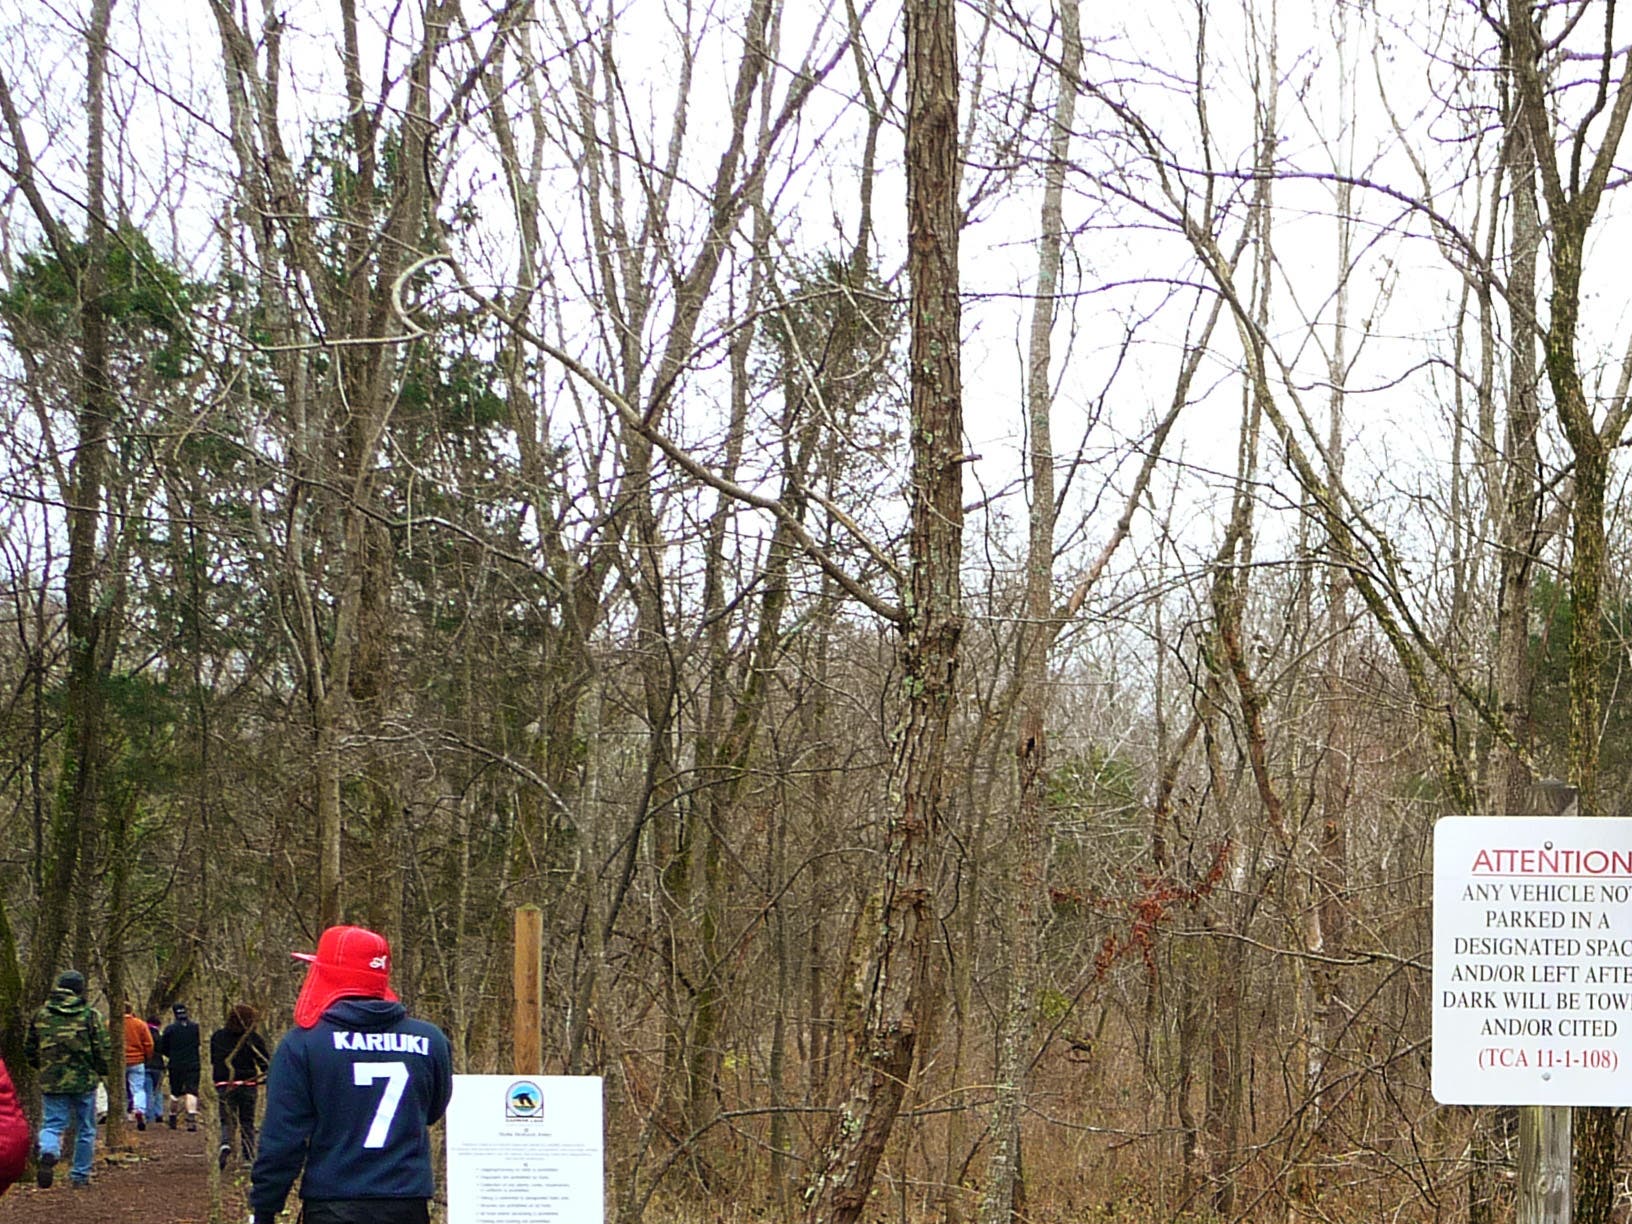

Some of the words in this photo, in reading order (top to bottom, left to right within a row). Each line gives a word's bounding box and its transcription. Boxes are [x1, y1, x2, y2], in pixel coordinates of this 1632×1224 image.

[1471, 849, 1632, 874] ATTENTION
[1462, 884, 1503, 902] ANY
[1509, 885, 1595, 902] VEHICLE
[1486, 910, 1565, 929] PARKED
[1571, 911, 1591, 929] IN
[1597, 912, 1610, 929] A
[1454, 938, 1580, 956] DESIGNATED
[1451, 964, 1524, 983] AND/OR
[1532, 965, 1580, 983] LEFT
[1443, 991, 1497, 1009] DARK
[1503, 992, 1550, 1009] WILL
[1556, 992, 1580, 1010] BE
[1480, 1018, 1551, 1037] AND/OR
[1558, 1019, 1617, 1037] CITED
[333, 1031, 429, 1056] KARIUKI
[1478, 1048, 1528, 1070] (TCA
[1536, 1049, 1618, 1072] 11-1-108)
[353, 1061, 410, 1149] 7
